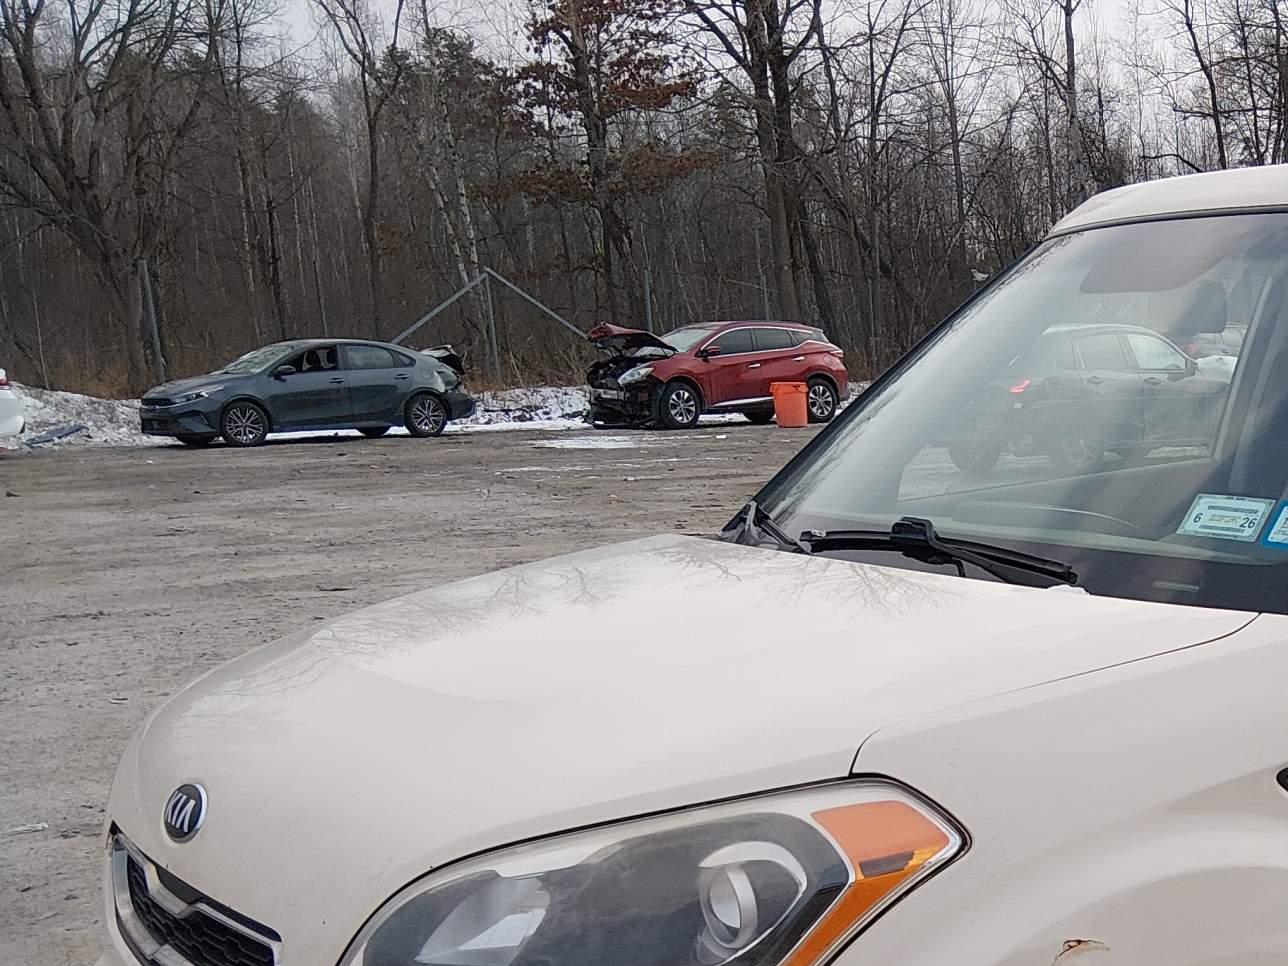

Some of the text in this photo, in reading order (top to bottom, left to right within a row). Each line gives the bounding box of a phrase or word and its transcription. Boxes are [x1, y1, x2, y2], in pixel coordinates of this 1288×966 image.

[1193, 512, 1203, 523] 6
[1239, 517, 1258, 528] 26
[164, 790, 196, 833] KIA
